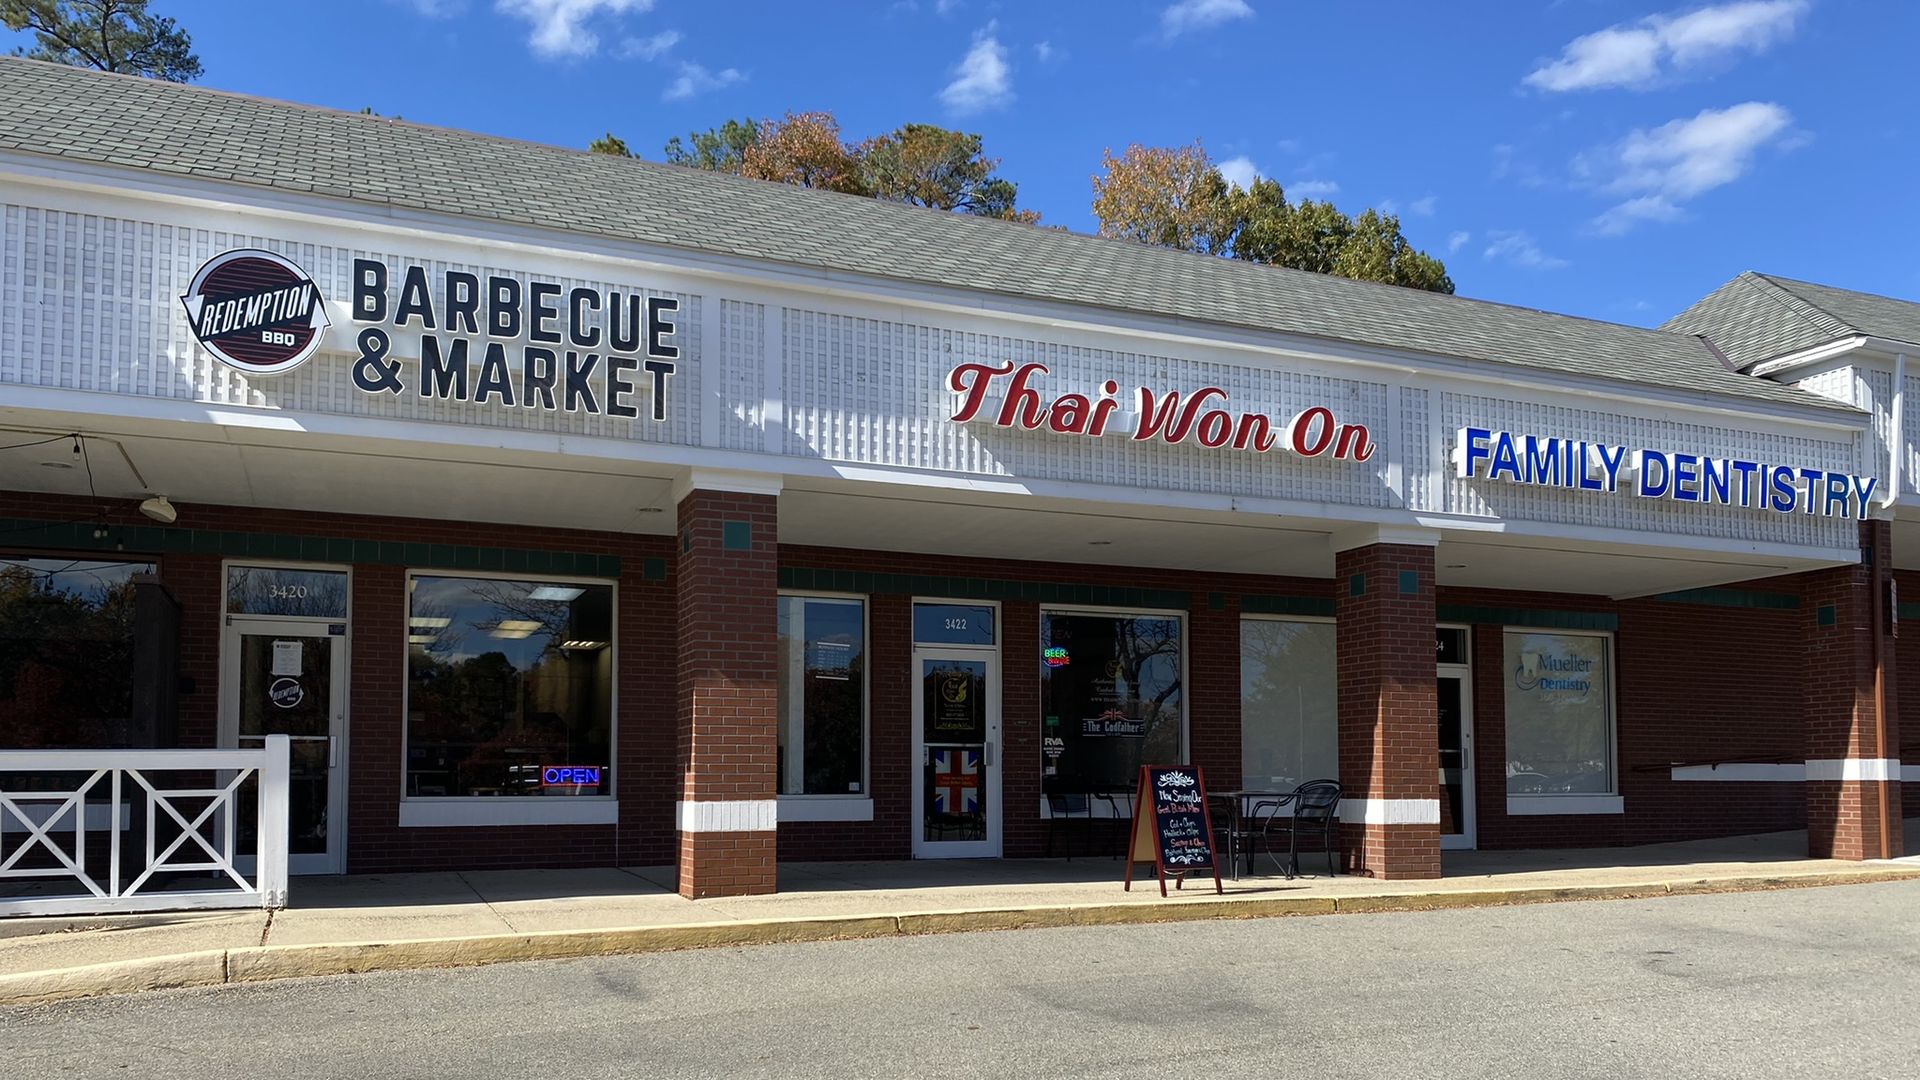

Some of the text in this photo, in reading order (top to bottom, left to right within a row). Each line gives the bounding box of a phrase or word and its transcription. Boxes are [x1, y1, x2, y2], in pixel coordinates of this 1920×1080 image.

[200, 283, 313, 338] REDEMPTION
[352, 257, 680, 359] BARBECUE
[261, 330, 295, 346] BBQ
[351, 326, 677, 421] & MARKET
[946, 359, 1377, 462] Thai Won On
[1457, 426, 1879, 520] FAMILY DENTISTRY
[269, 585, 307, 598] 3420
[945, 618, 967, 630] 3422
[1044, 648, 1066, 658] BEER
[1538, 654, 1592, 673] Mueller
[1539, 677, 1592, 697] Dentistry
[1087, 720, 1140, 733] The Codfather
[1044, 737, 1064, 746] RVA
[545, 768, 599, 783] OPEN
